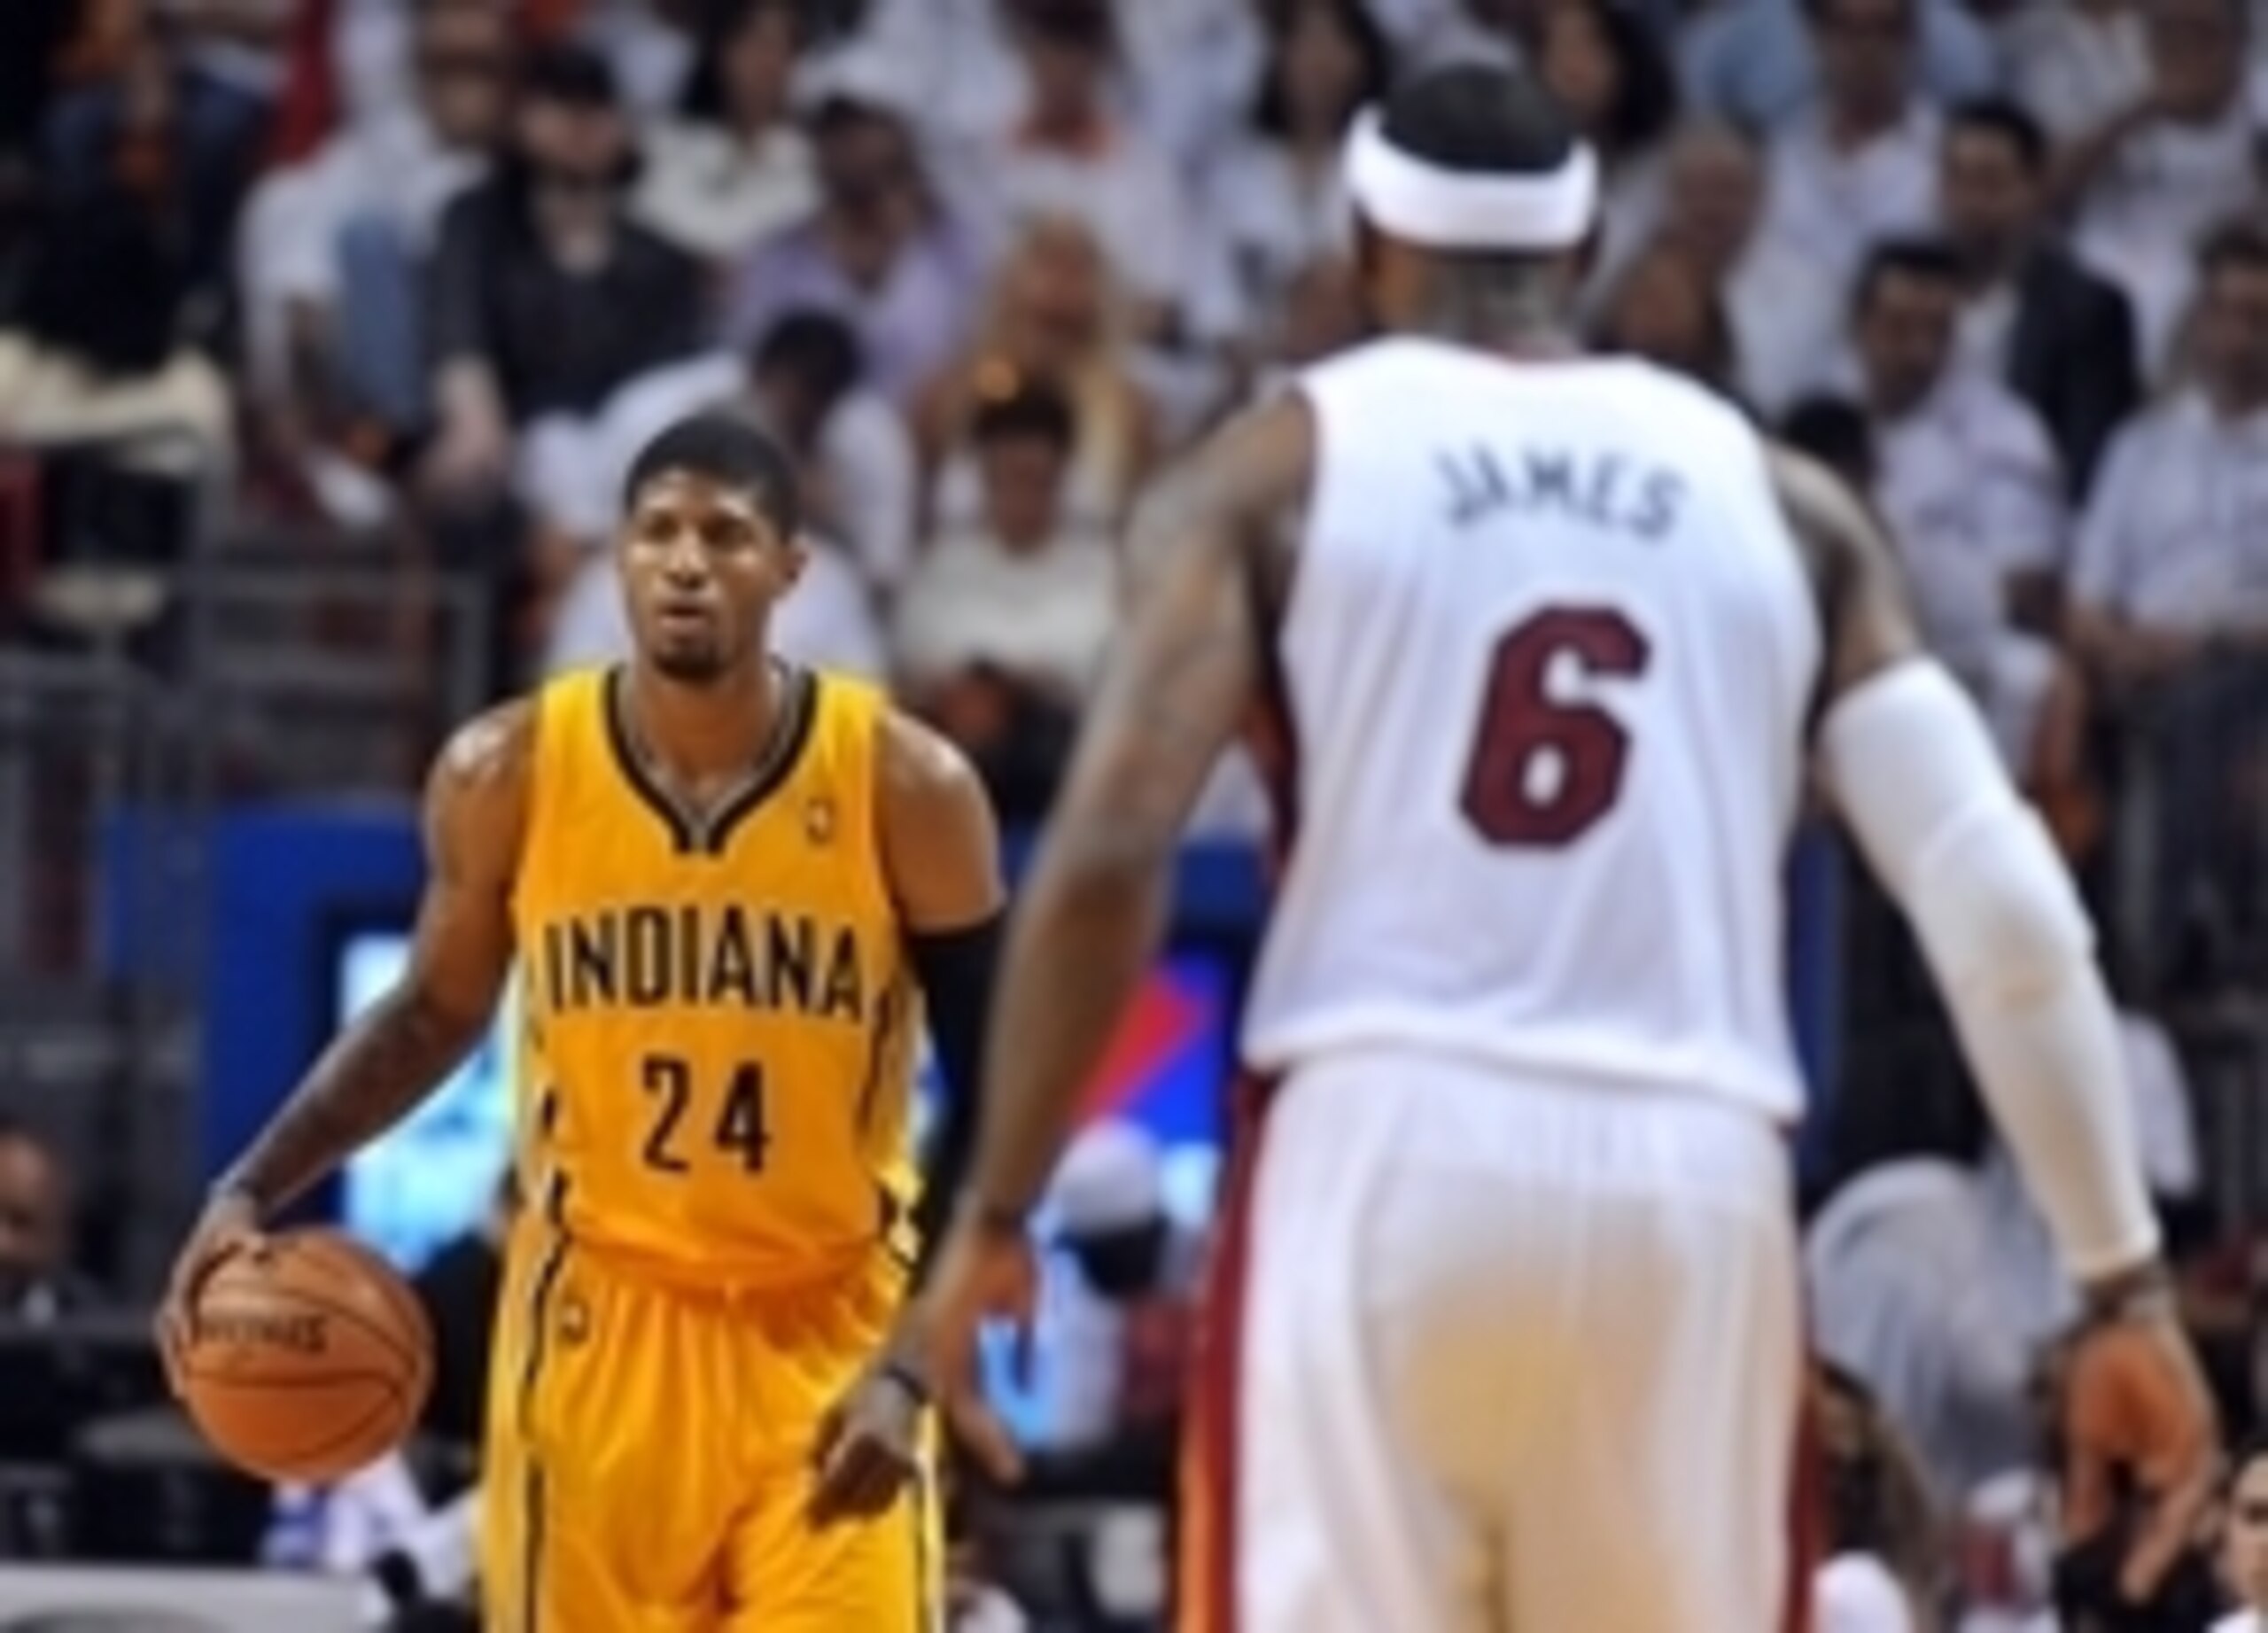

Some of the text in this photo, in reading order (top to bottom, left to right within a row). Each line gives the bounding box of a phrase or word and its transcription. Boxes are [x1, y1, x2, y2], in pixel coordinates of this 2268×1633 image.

[1433, 441, 1688, 541] JAMES
[1456, 603, 1653, 850] 6
[544, 905, 863, 1026] INDIANA
[641, 1051, 771, 1175] 24
